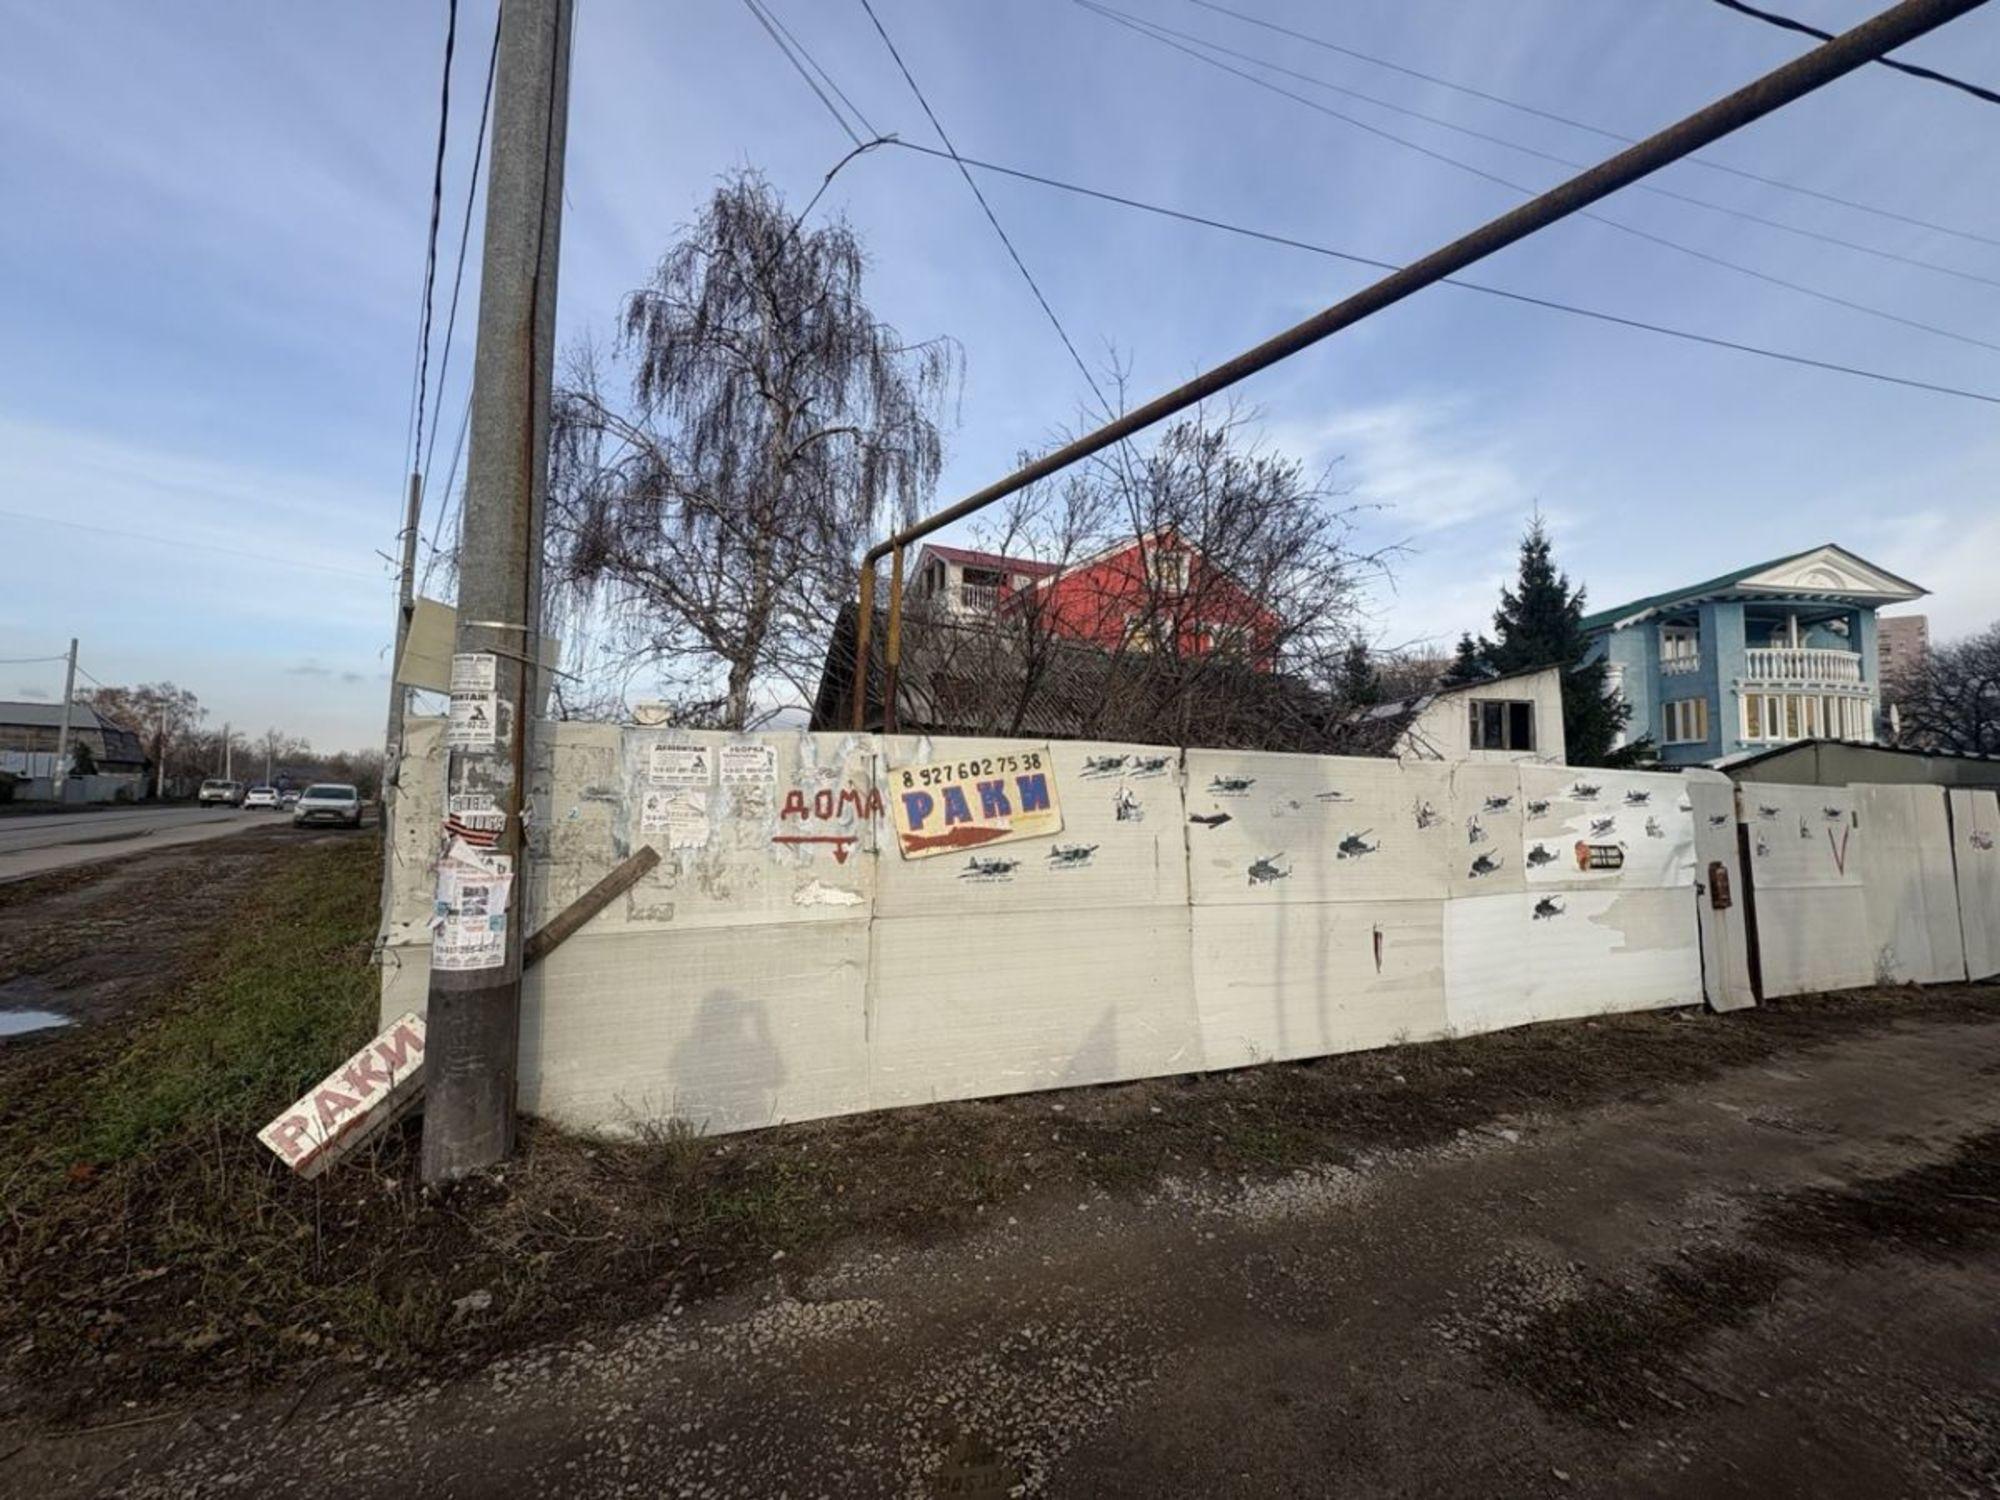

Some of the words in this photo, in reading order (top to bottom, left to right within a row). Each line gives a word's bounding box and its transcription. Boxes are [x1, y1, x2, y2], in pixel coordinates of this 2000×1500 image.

[901, 773, 1051, 832] РАКИ
[902, 771, 914, 788] 8
[780, 787, 885, 821] ДОМА
[267, 1024, 425, 1159] РАКИ
